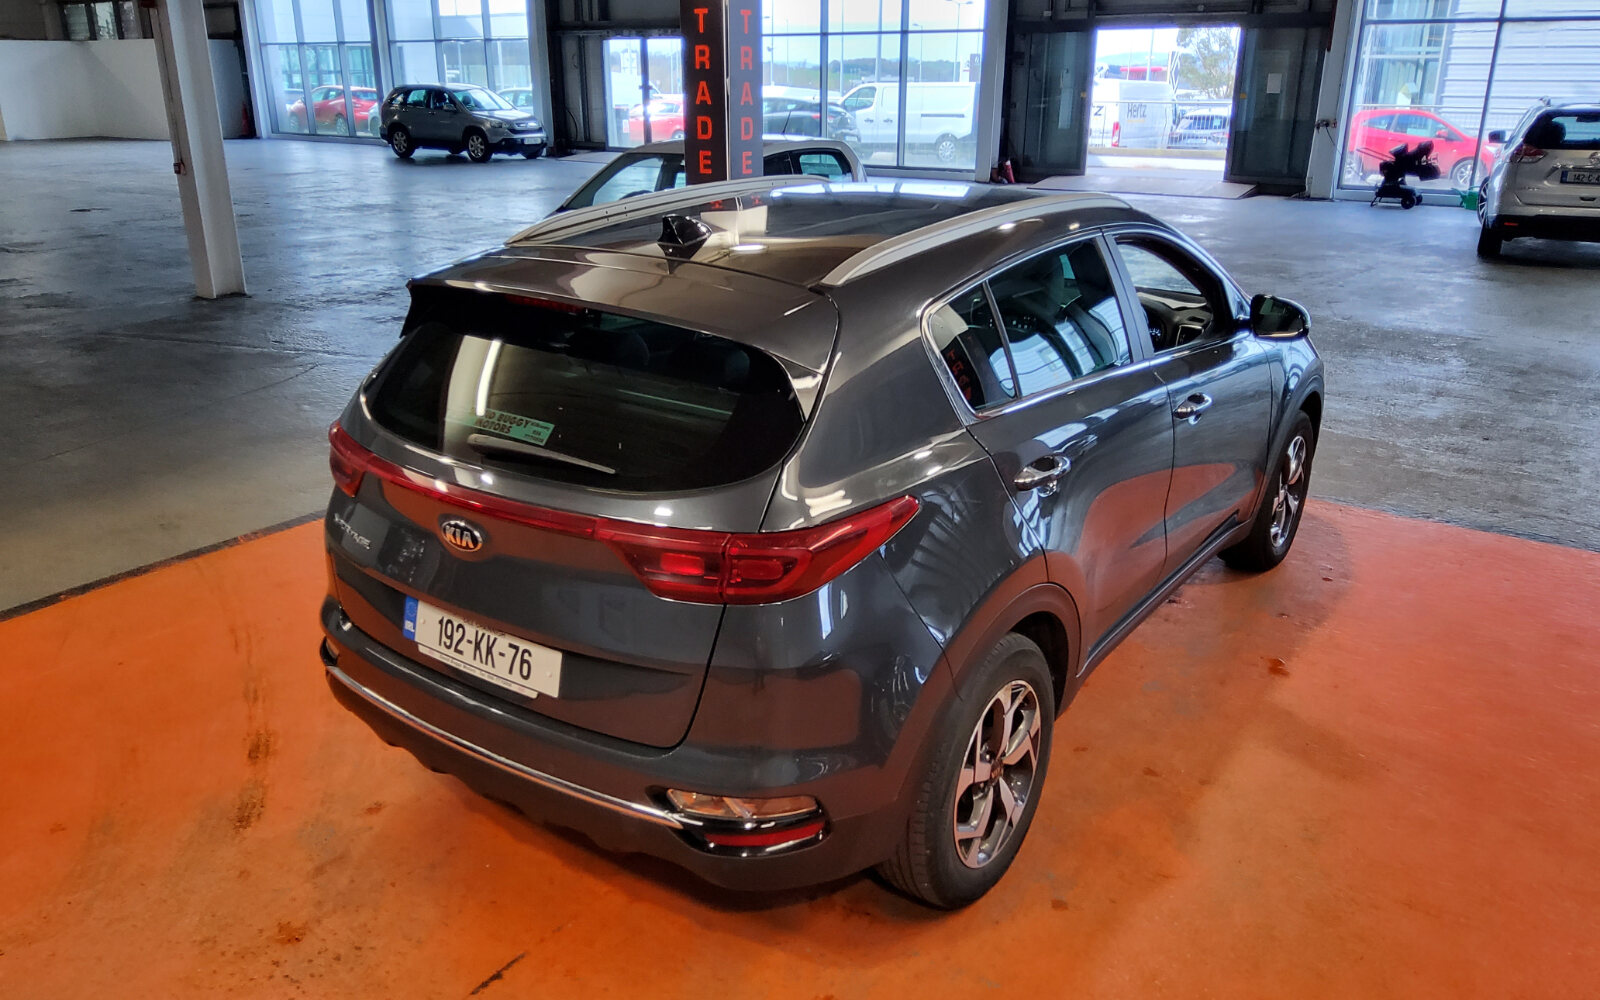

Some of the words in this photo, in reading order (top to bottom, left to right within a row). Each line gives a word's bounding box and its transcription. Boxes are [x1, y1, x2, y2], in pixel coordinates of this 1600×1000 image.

[693, 8, 713, 175] TRADE
[740, 9, 754, 175] TRADE
[1127, 102, 1147, 119] Hertz
[497, 413, 531, 428] BUGGY
[445, 524, 476, 549] KIA
[438, 616, 532, 681] 192-KK-76
